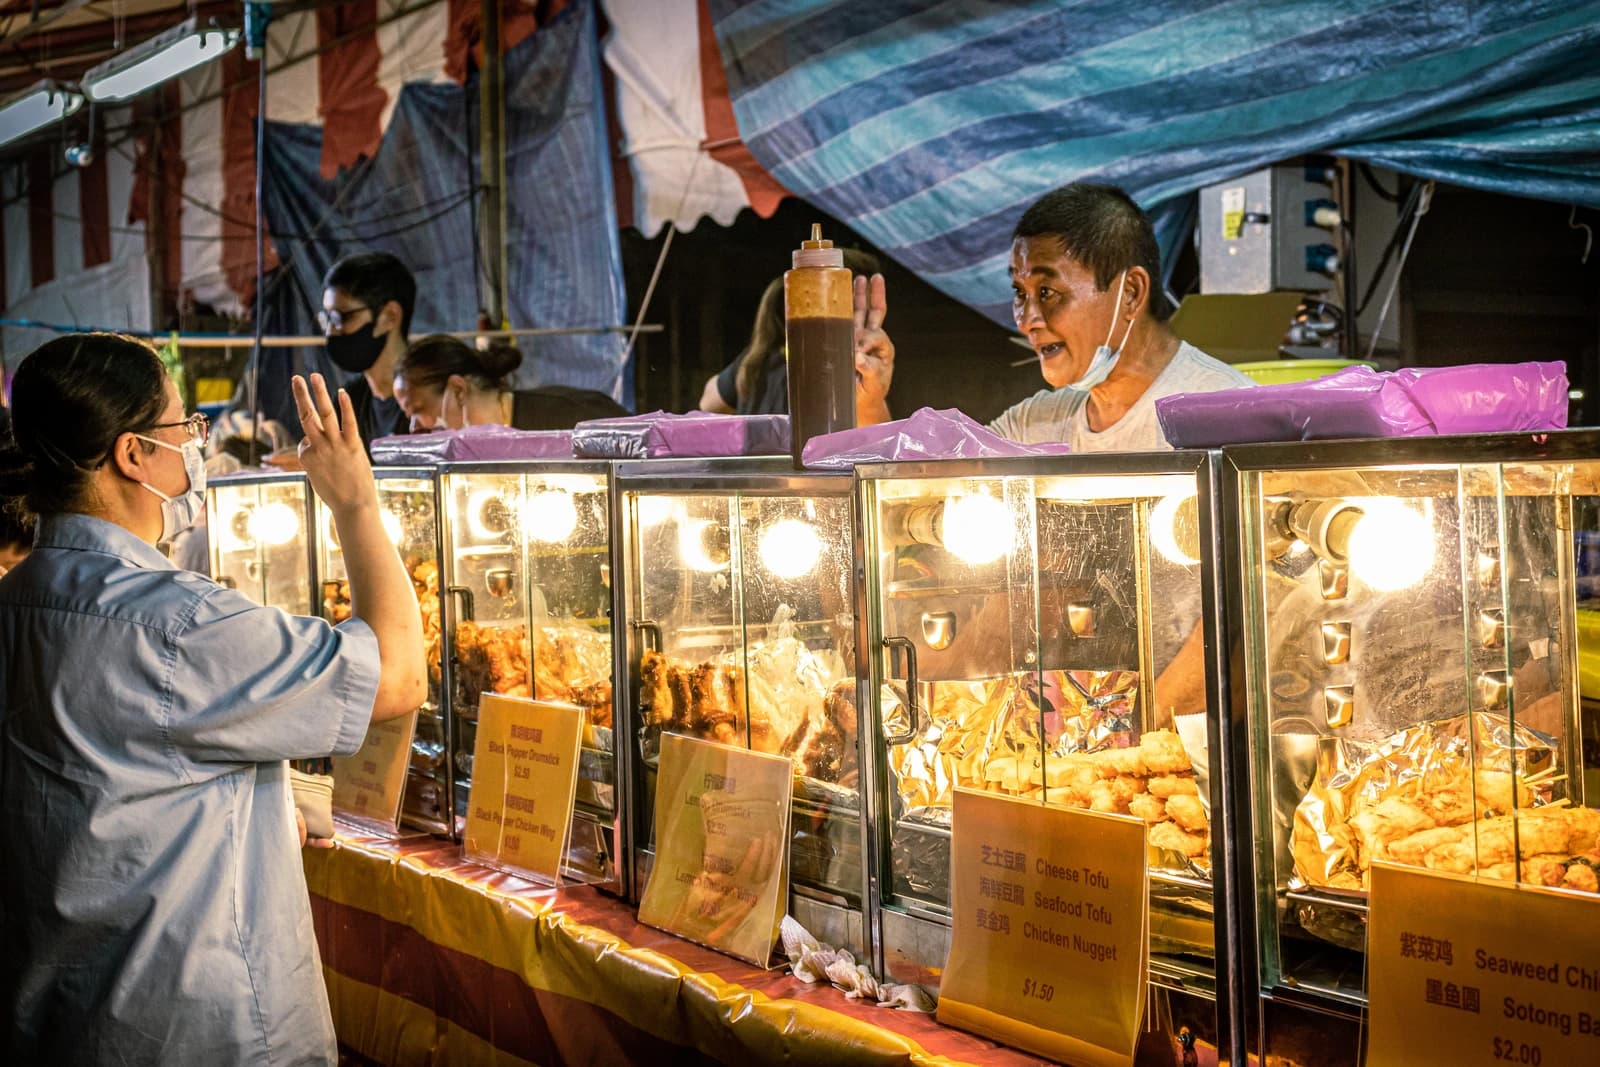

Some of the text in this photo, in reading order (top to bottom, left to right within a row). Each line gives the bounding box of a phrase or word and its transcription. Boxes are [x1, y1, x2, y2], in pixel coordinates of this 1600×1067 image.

[1036, 858, 1079, 883] Cheese
[1082, 868, 1109, 889] Tofu
[1034, 891, 1082, 918] Seafood
[1085, 902, 1112, 925] Tofu
[1023, 921, 1070, 949] Chicken
[1073, 934, 1117, 962] Nugget
[1400, 931, 1600, 992] 紫菜鸡 Seaweed Chi
[1022, 977, 1054, 1002] $1.50
[1503, 996, 1571, 1036] Sotong
[1493, 1036, 1542, 1066] $2.00
